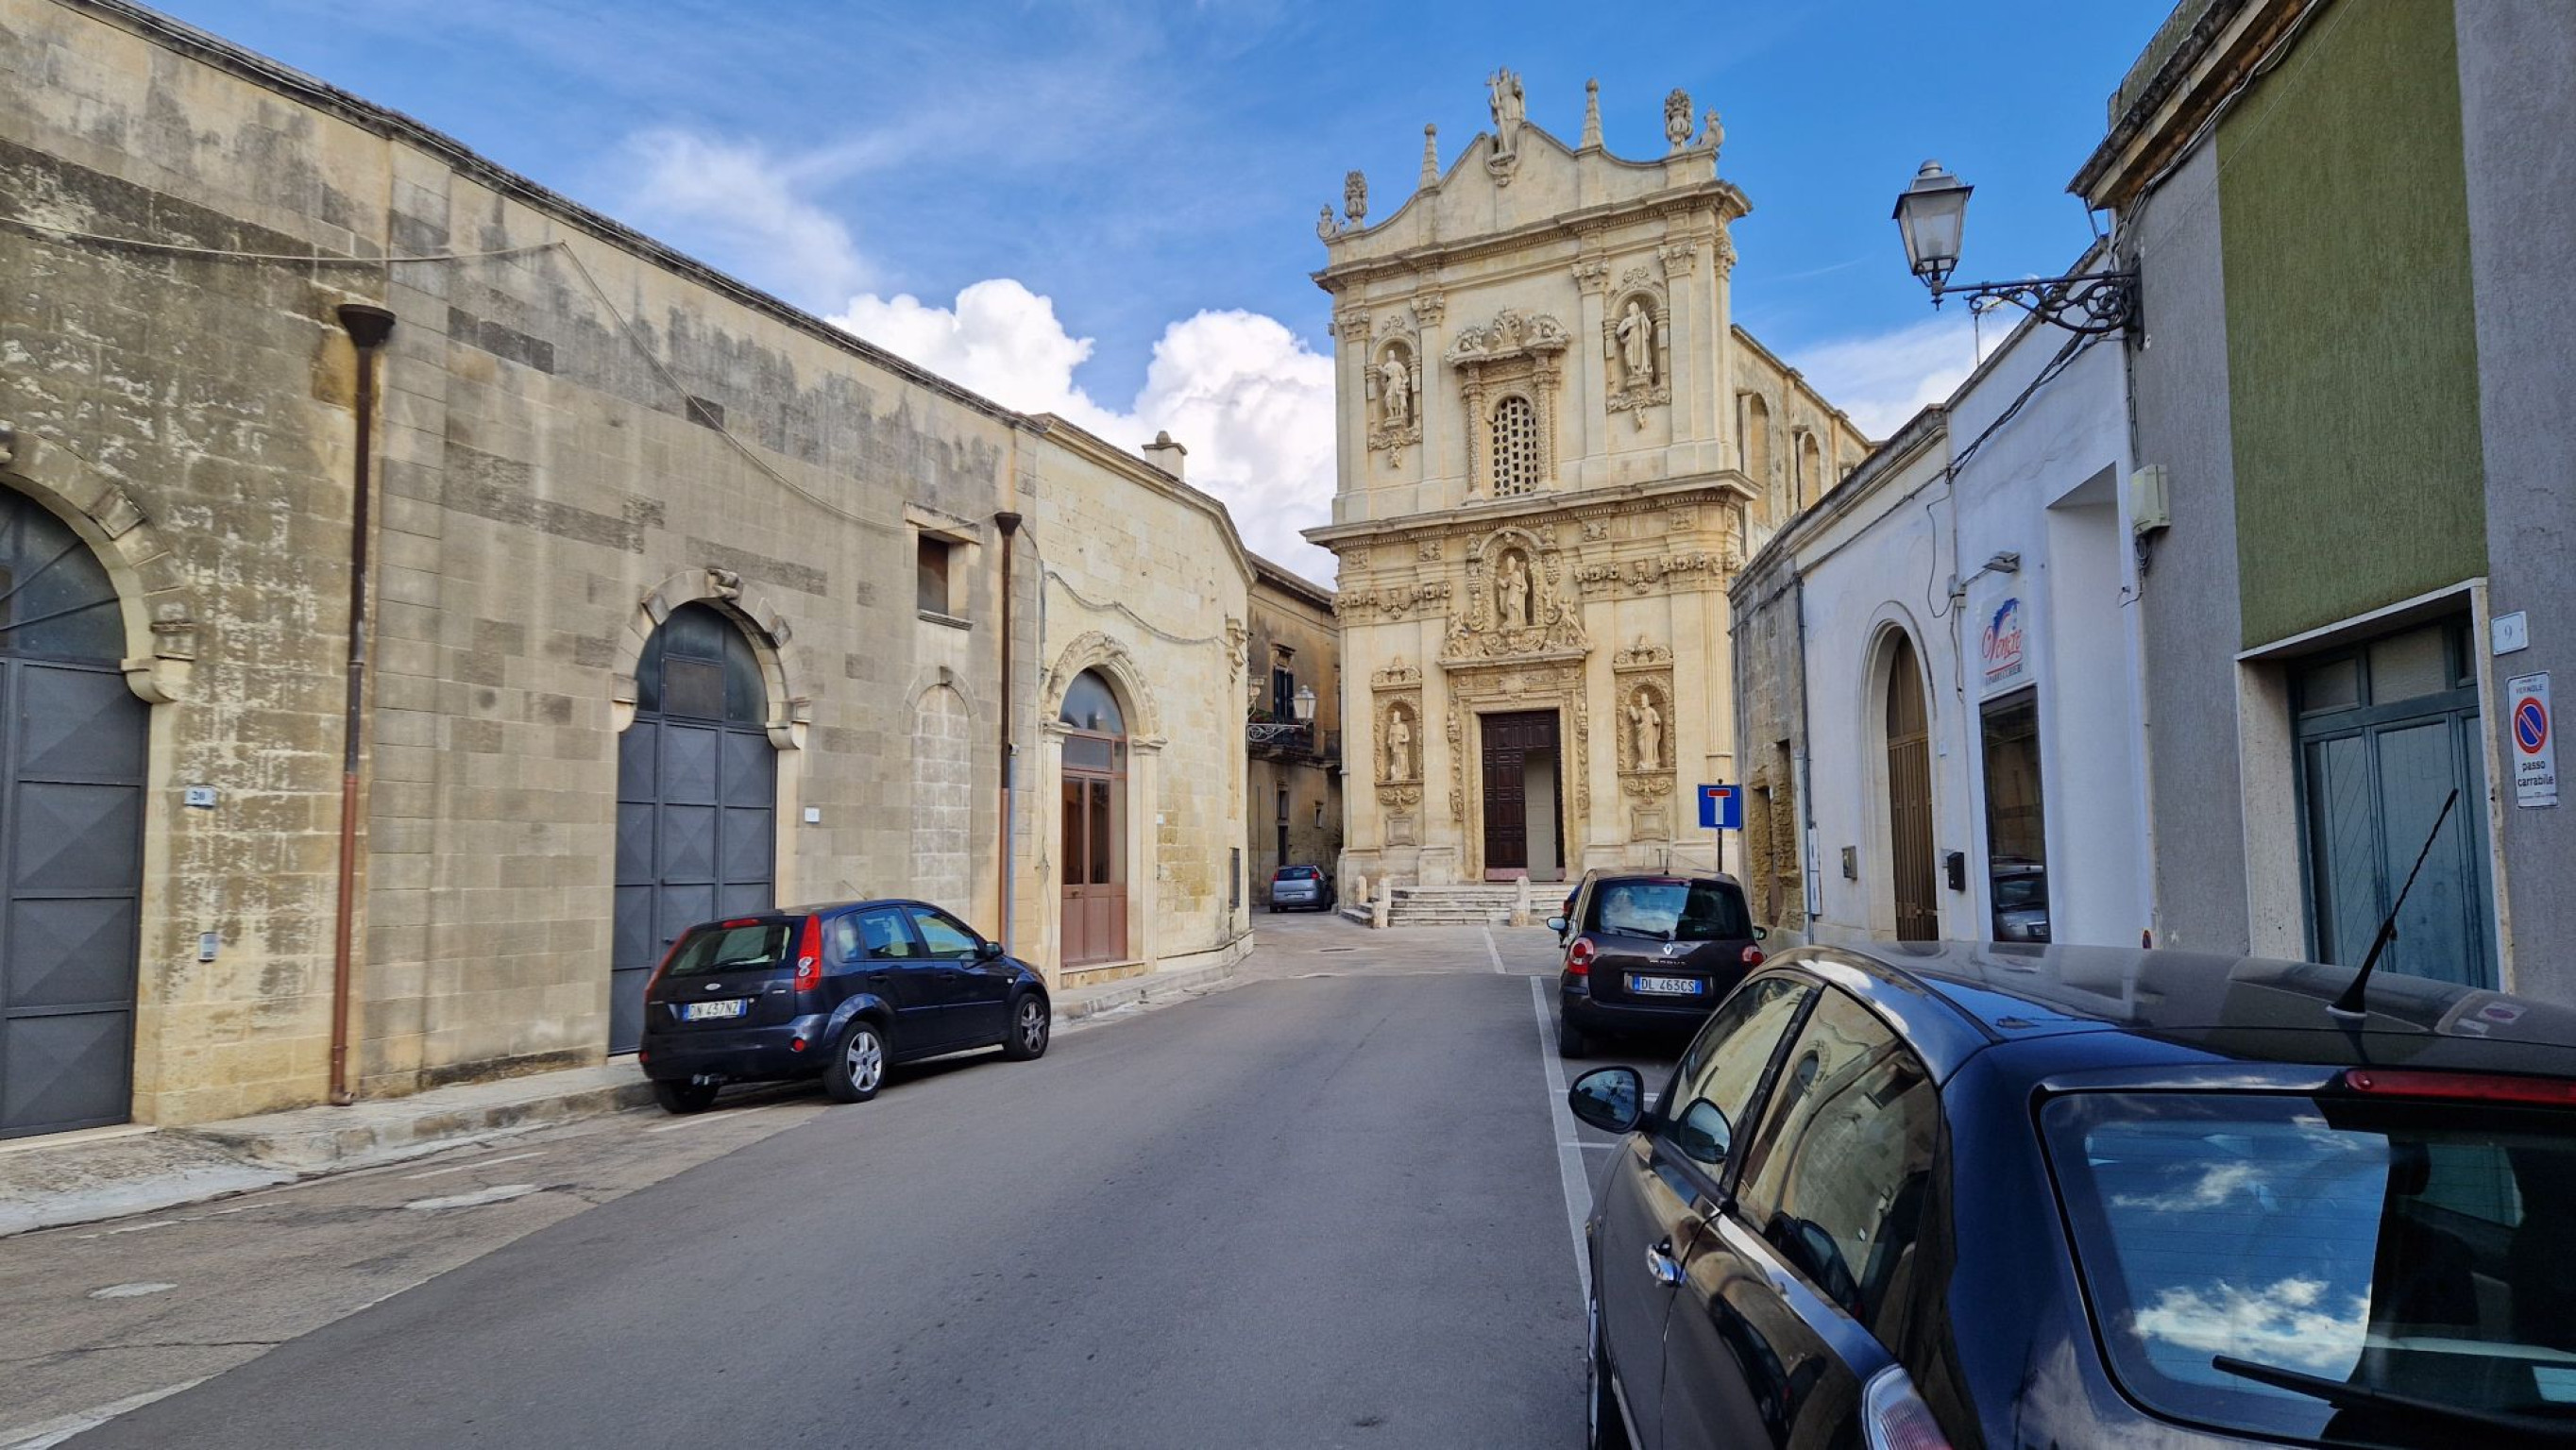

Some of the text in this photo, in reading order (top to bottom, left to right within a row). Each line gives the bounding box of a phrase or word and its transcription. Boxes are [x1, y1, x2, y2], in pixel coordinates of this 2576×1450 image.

[2504, 624, 2513, 639] 9
[2522, 761, 2546, 772] passo
[2517, 774, 2554, 786] carrabile
[1641, 978, 1695, 992] DL 463CS
[706, 1001, 738, 1016] 437NZ
